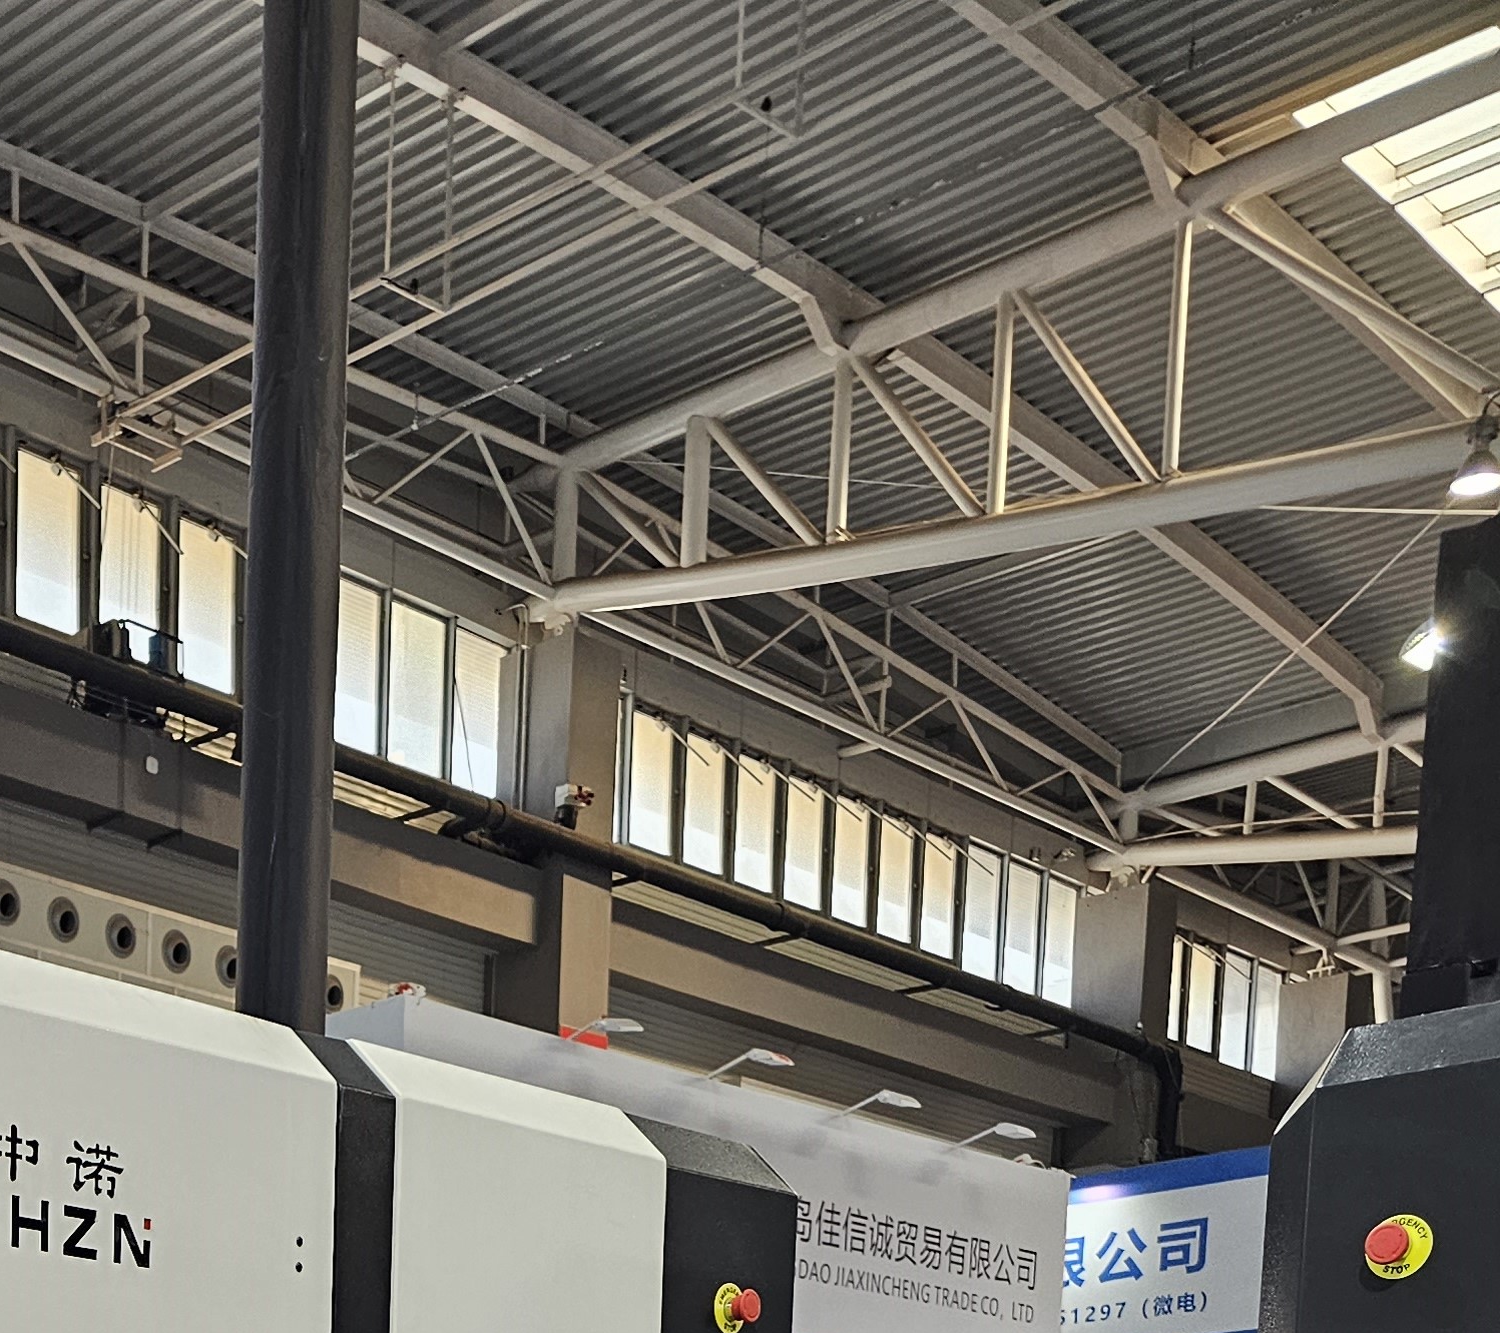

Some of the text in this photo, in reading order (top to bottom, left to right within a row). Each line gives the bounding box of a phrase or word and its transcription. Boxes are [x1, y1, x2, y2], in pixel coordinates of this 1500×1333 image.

[1383, 1263, 1410, 1275] STOP
[834, 1265, 931, 1304] JIAXINCHENG
[1011, 1301, 1035, 1323] LTD
